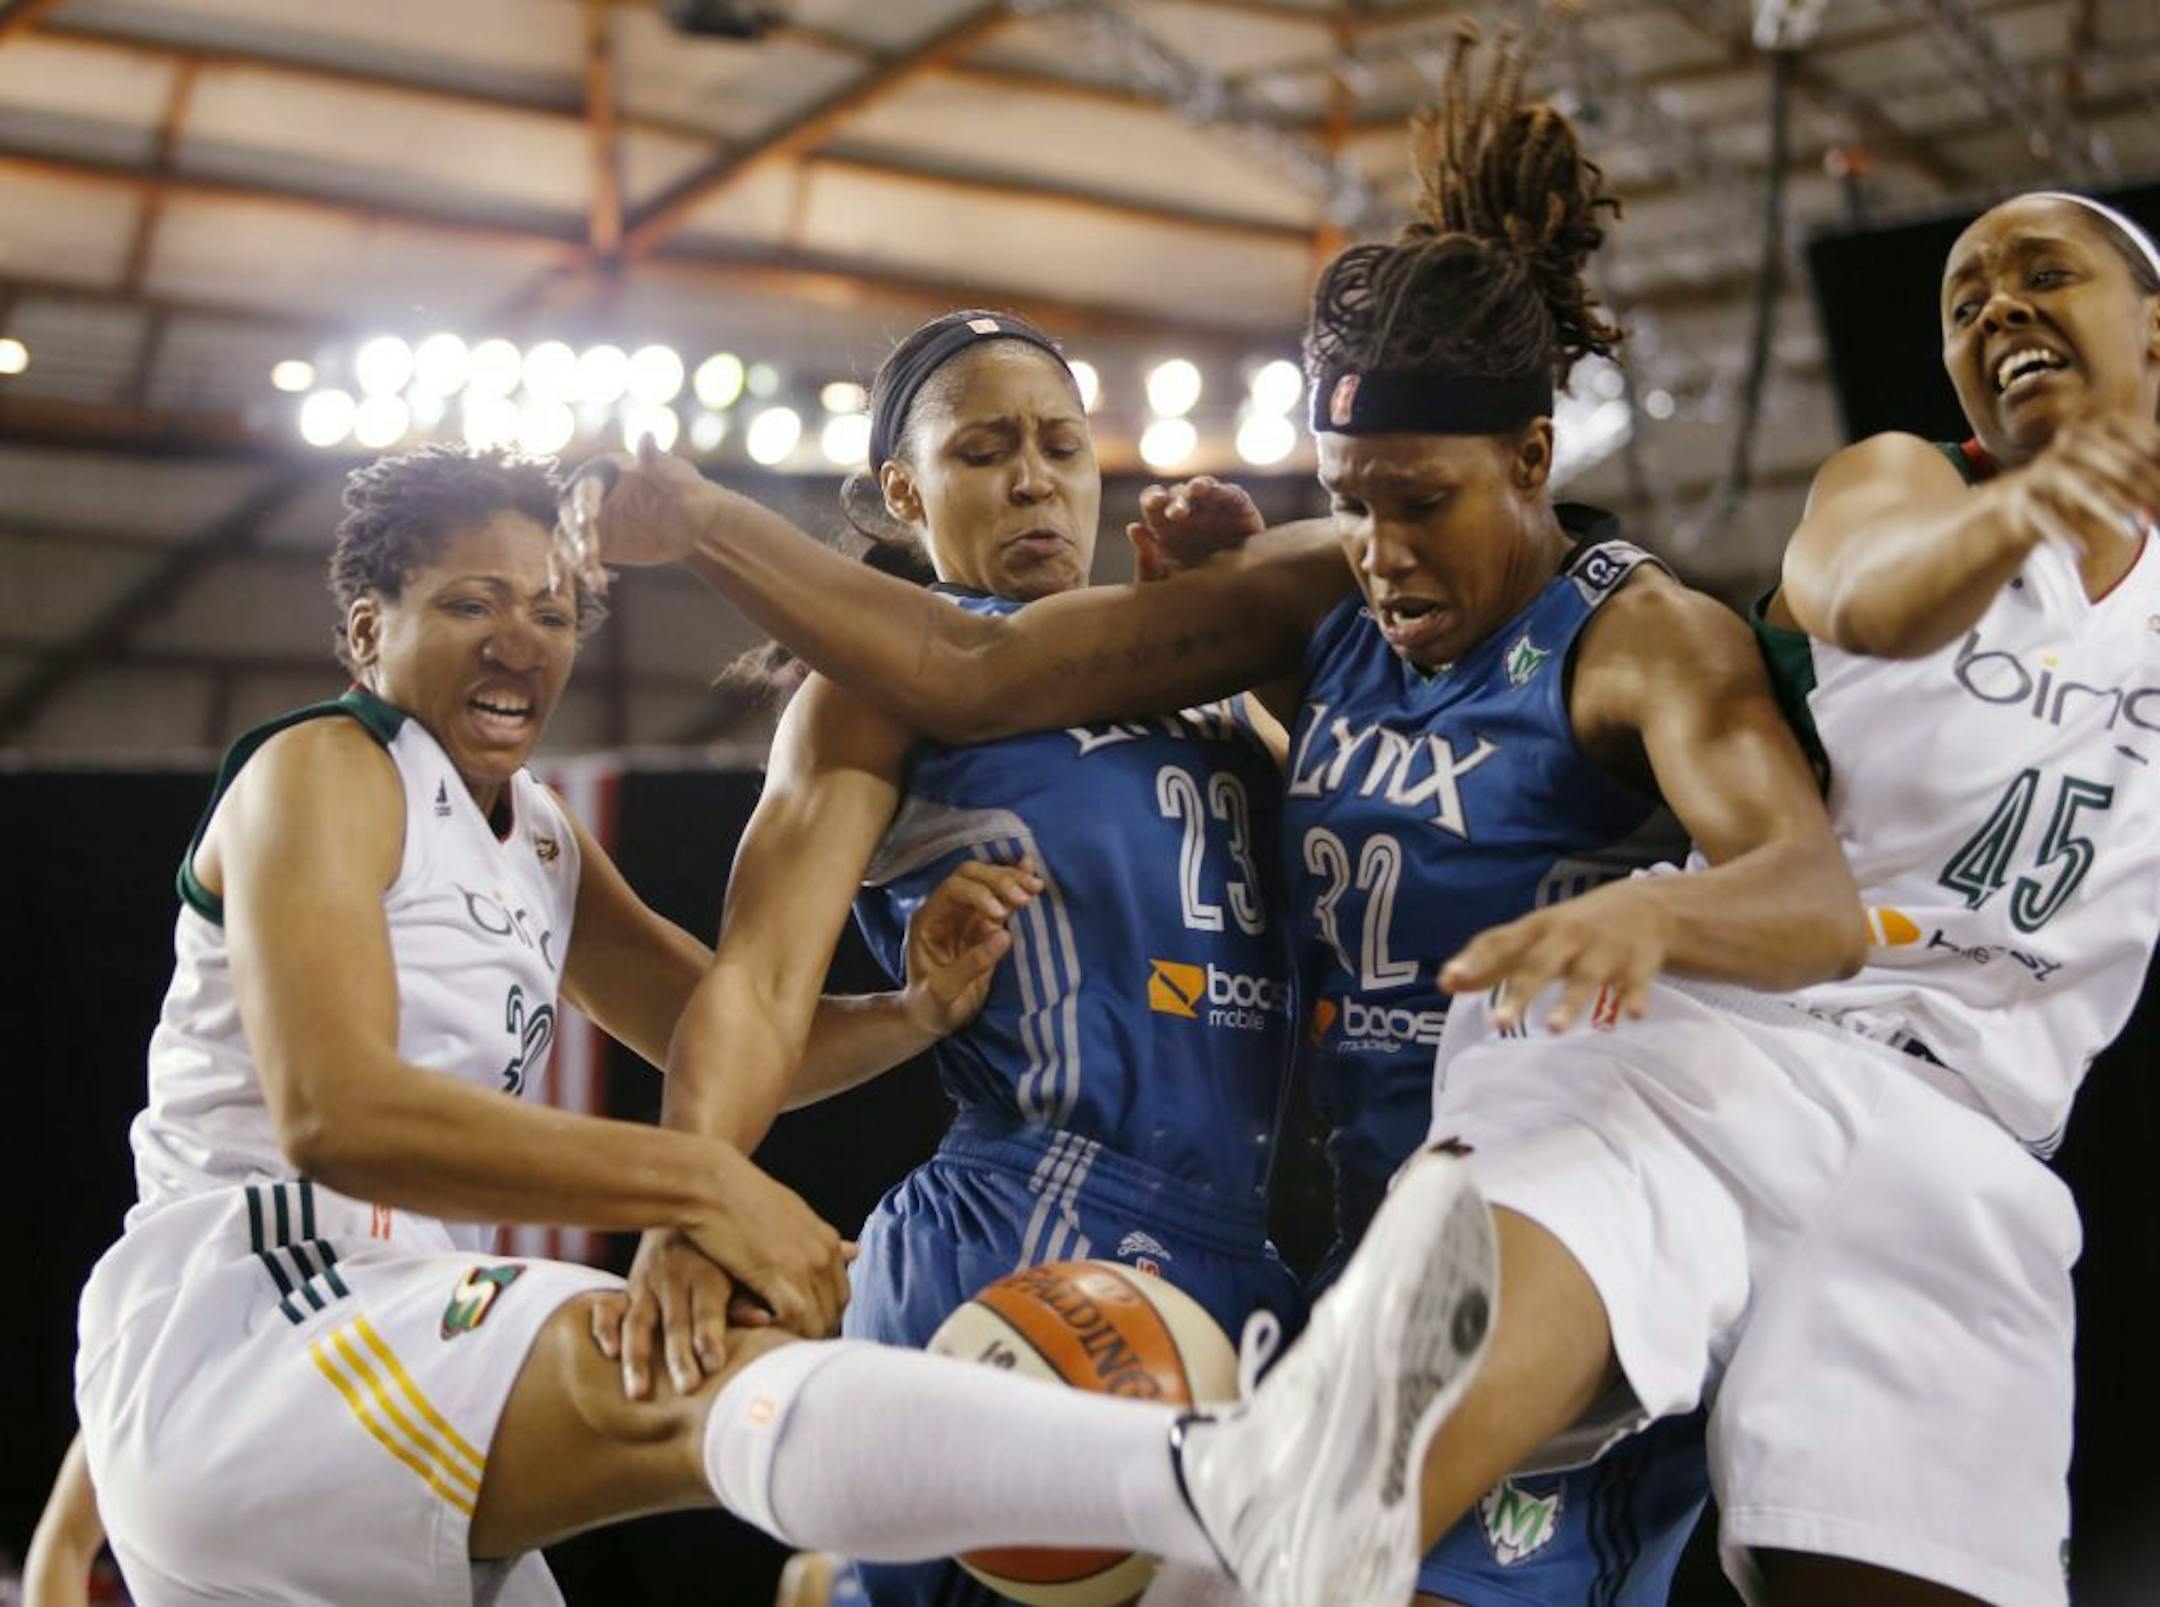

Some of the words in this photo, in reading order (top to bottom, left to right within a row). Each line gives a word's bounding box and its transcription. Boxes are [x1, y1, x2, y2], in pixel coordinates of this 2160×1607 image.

[1157, 765, 1266, 936] 23
[1302, 826, 1419, 992] 32
[1937, 768, 2115, 935] 45
[1342, 994, 1448, 1045] boos
